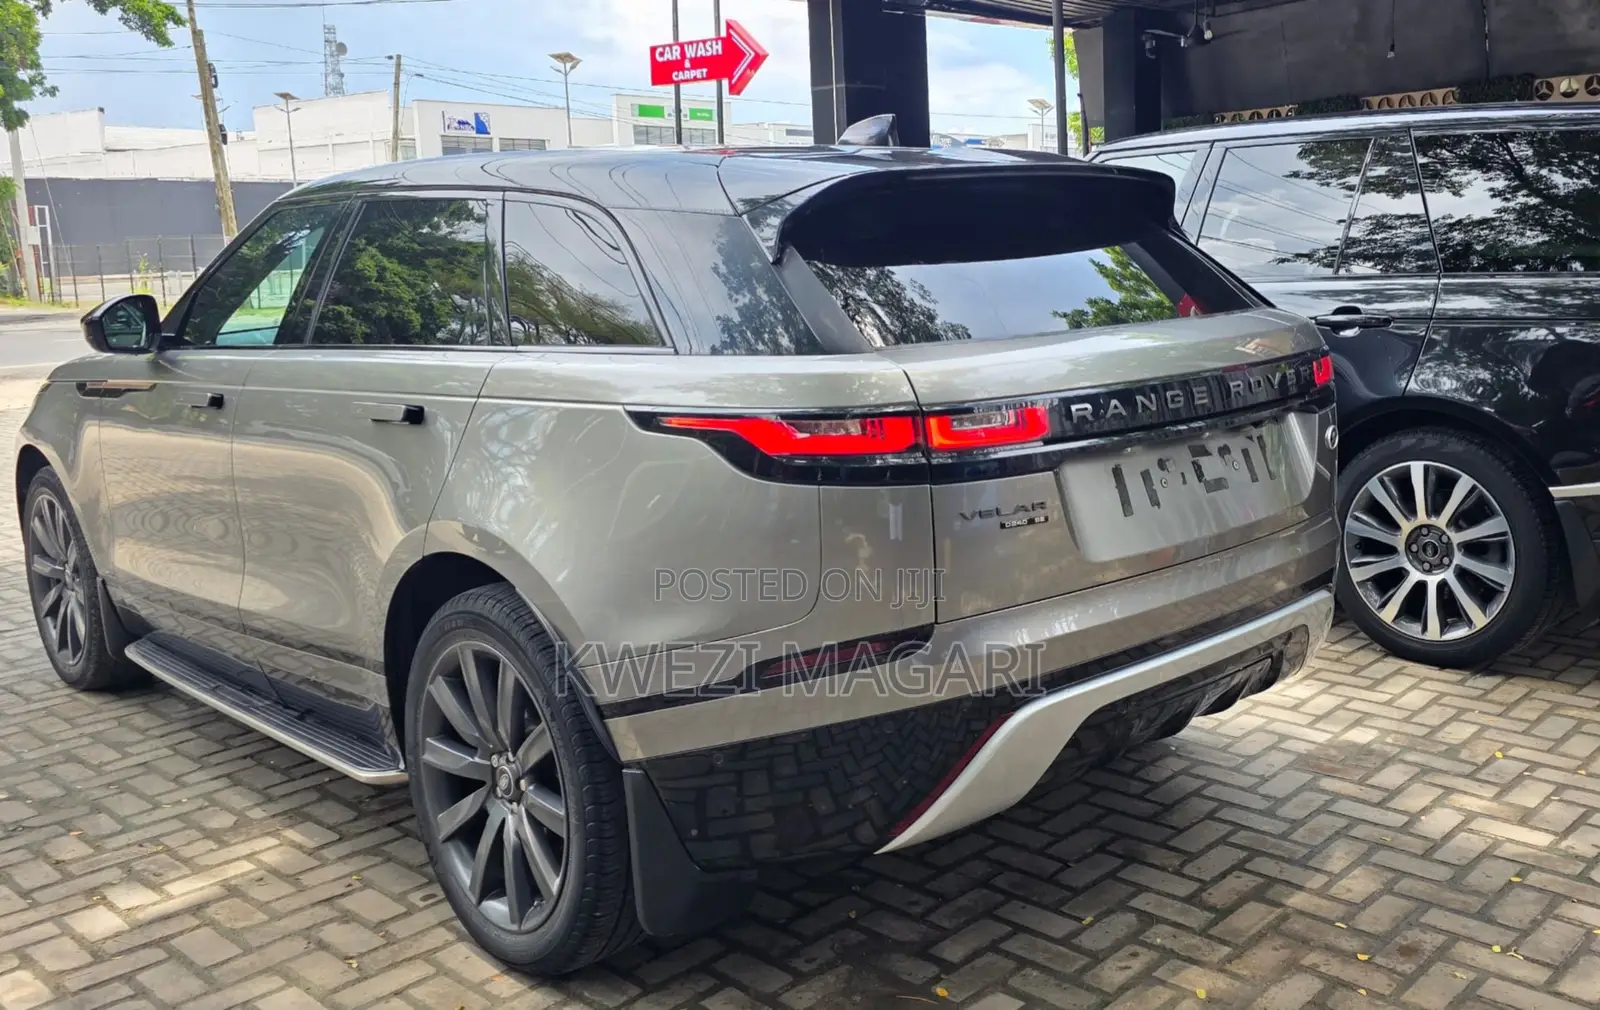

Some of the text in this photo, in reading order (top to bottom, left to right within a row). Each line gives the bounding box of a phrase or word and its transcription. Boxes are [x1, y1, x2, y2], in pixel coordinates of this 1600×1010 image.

[655, 40, 722, 62] CAR WASH
[684, 59, 691, 68] &
[672, 68, 708, 81] CARPET
[1070, 363, 1311, 425] RANGE ROVER
[958, 501, 1047, 521] VELAR
